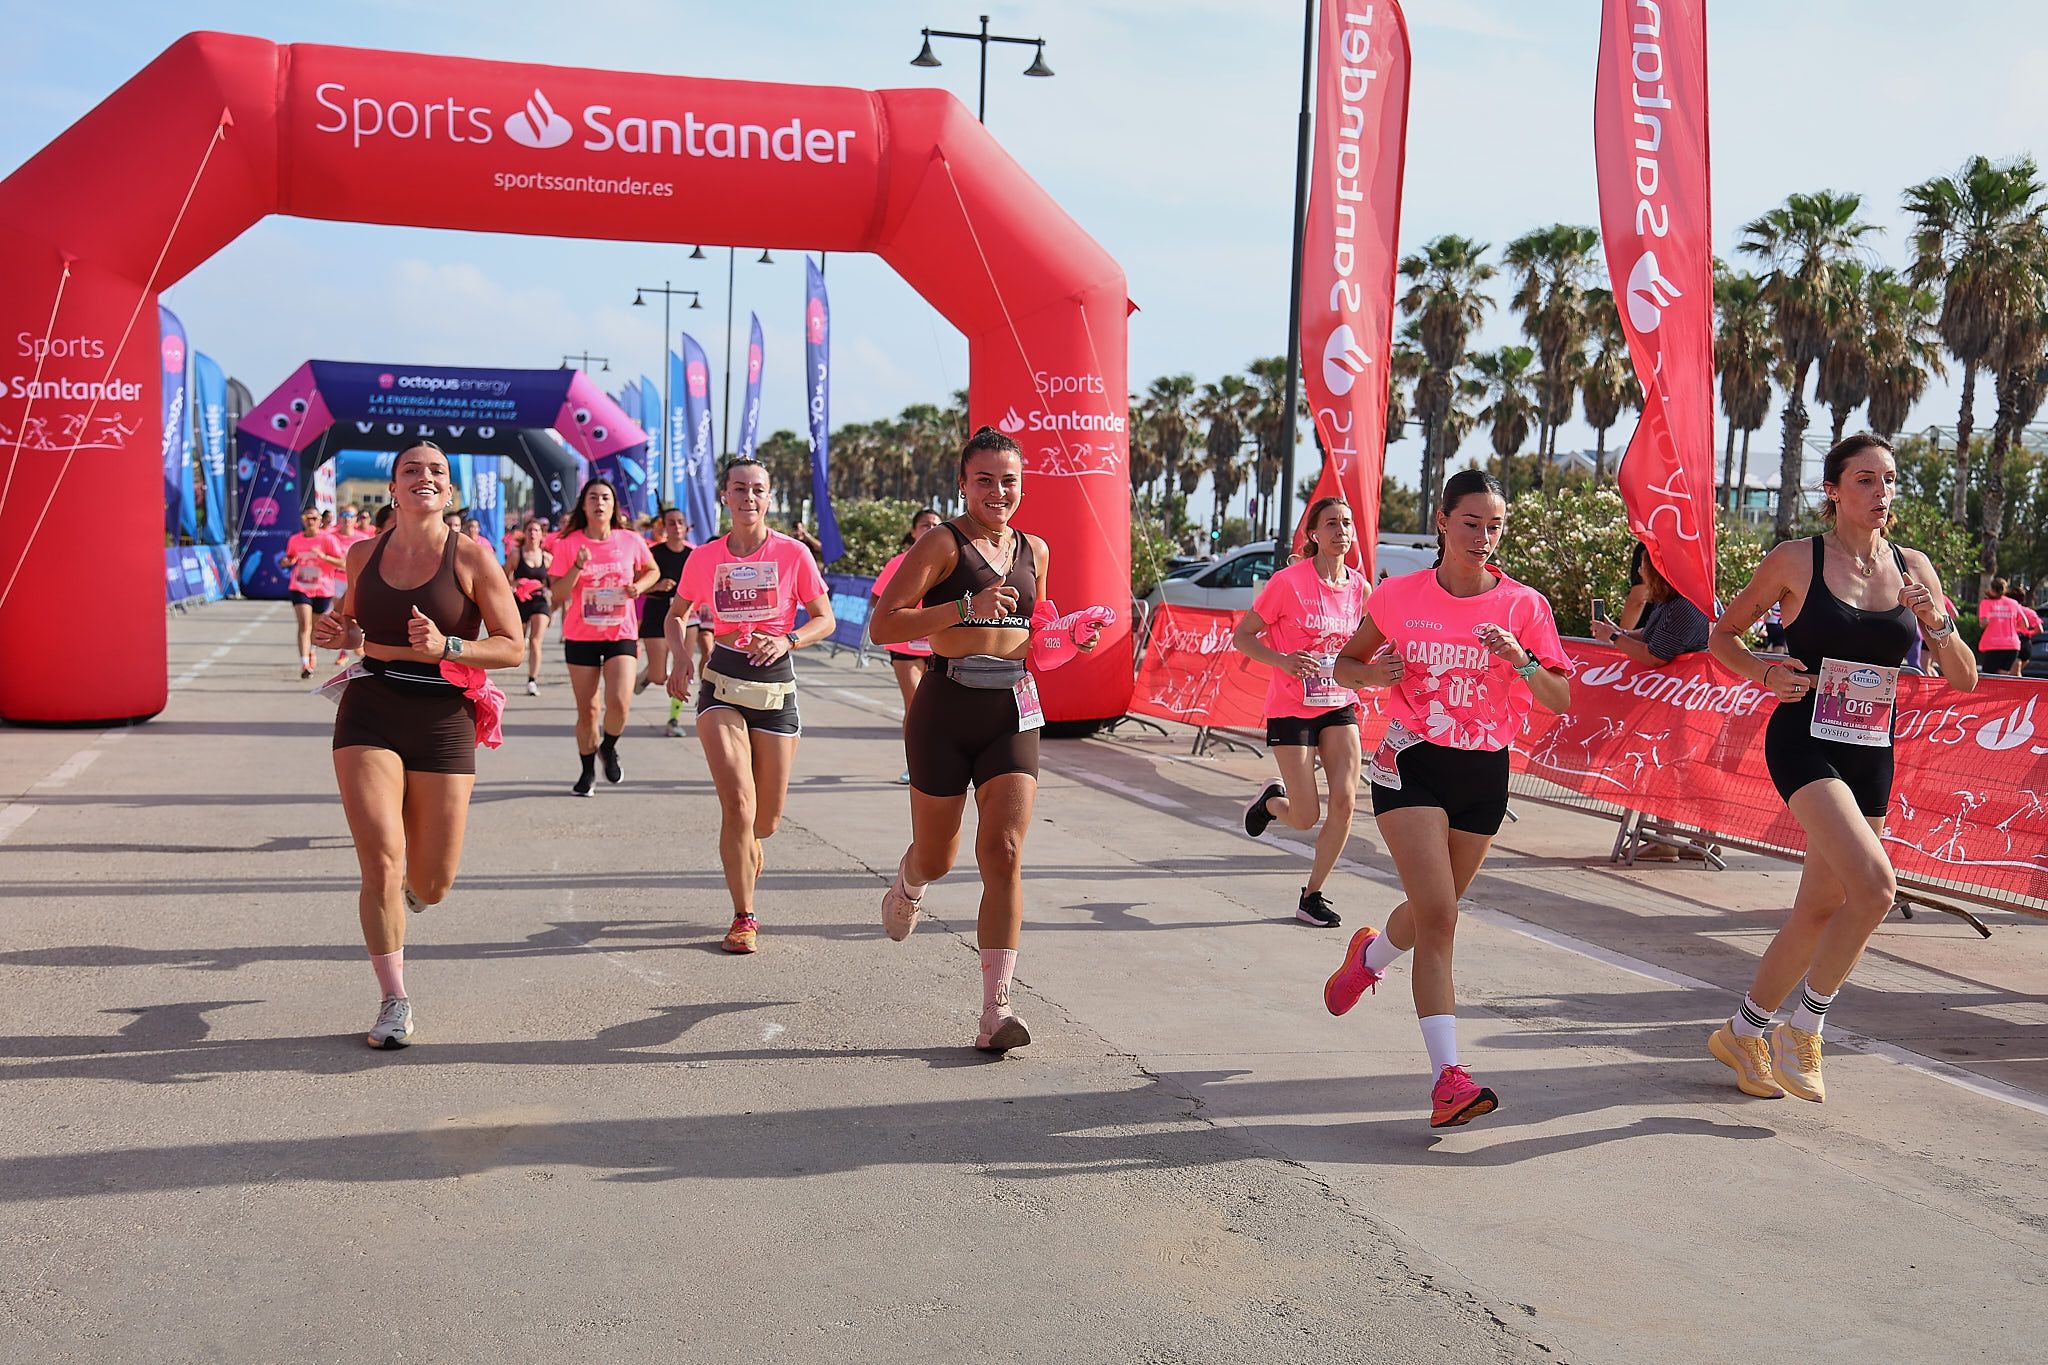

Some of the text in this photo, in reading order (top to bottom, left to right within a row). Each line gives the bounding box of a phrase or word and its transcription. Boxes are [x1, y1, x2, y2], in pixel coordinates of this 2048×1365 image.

[315, 82, 856, 164] Sports Santander
[493, 171, 674, 197] sportssantander.es
[17, 332, 105, 362] Sports
[11, 375, 143, 401] Santander
[1035, 370, 1105, 398] Sports
[355, 421, 496, 439] VOLVO
[1028, 410, 1126, 433] Santander
[732, 589, 758, 601] 016
[1001, 616, 1022, 626] PRO
[1405, 619, 1443, 631] OYSHO
[1043, 637, 1062, 648] 2026
[1612, 669, 1776, 716] Santander
[1845, 699, 1873, 715] 016
[1821, 718, 1842, 726] CARRERA
[1895, 704, 1979, 744] orts
[1820, 727, 1850, 738] OYSHO
